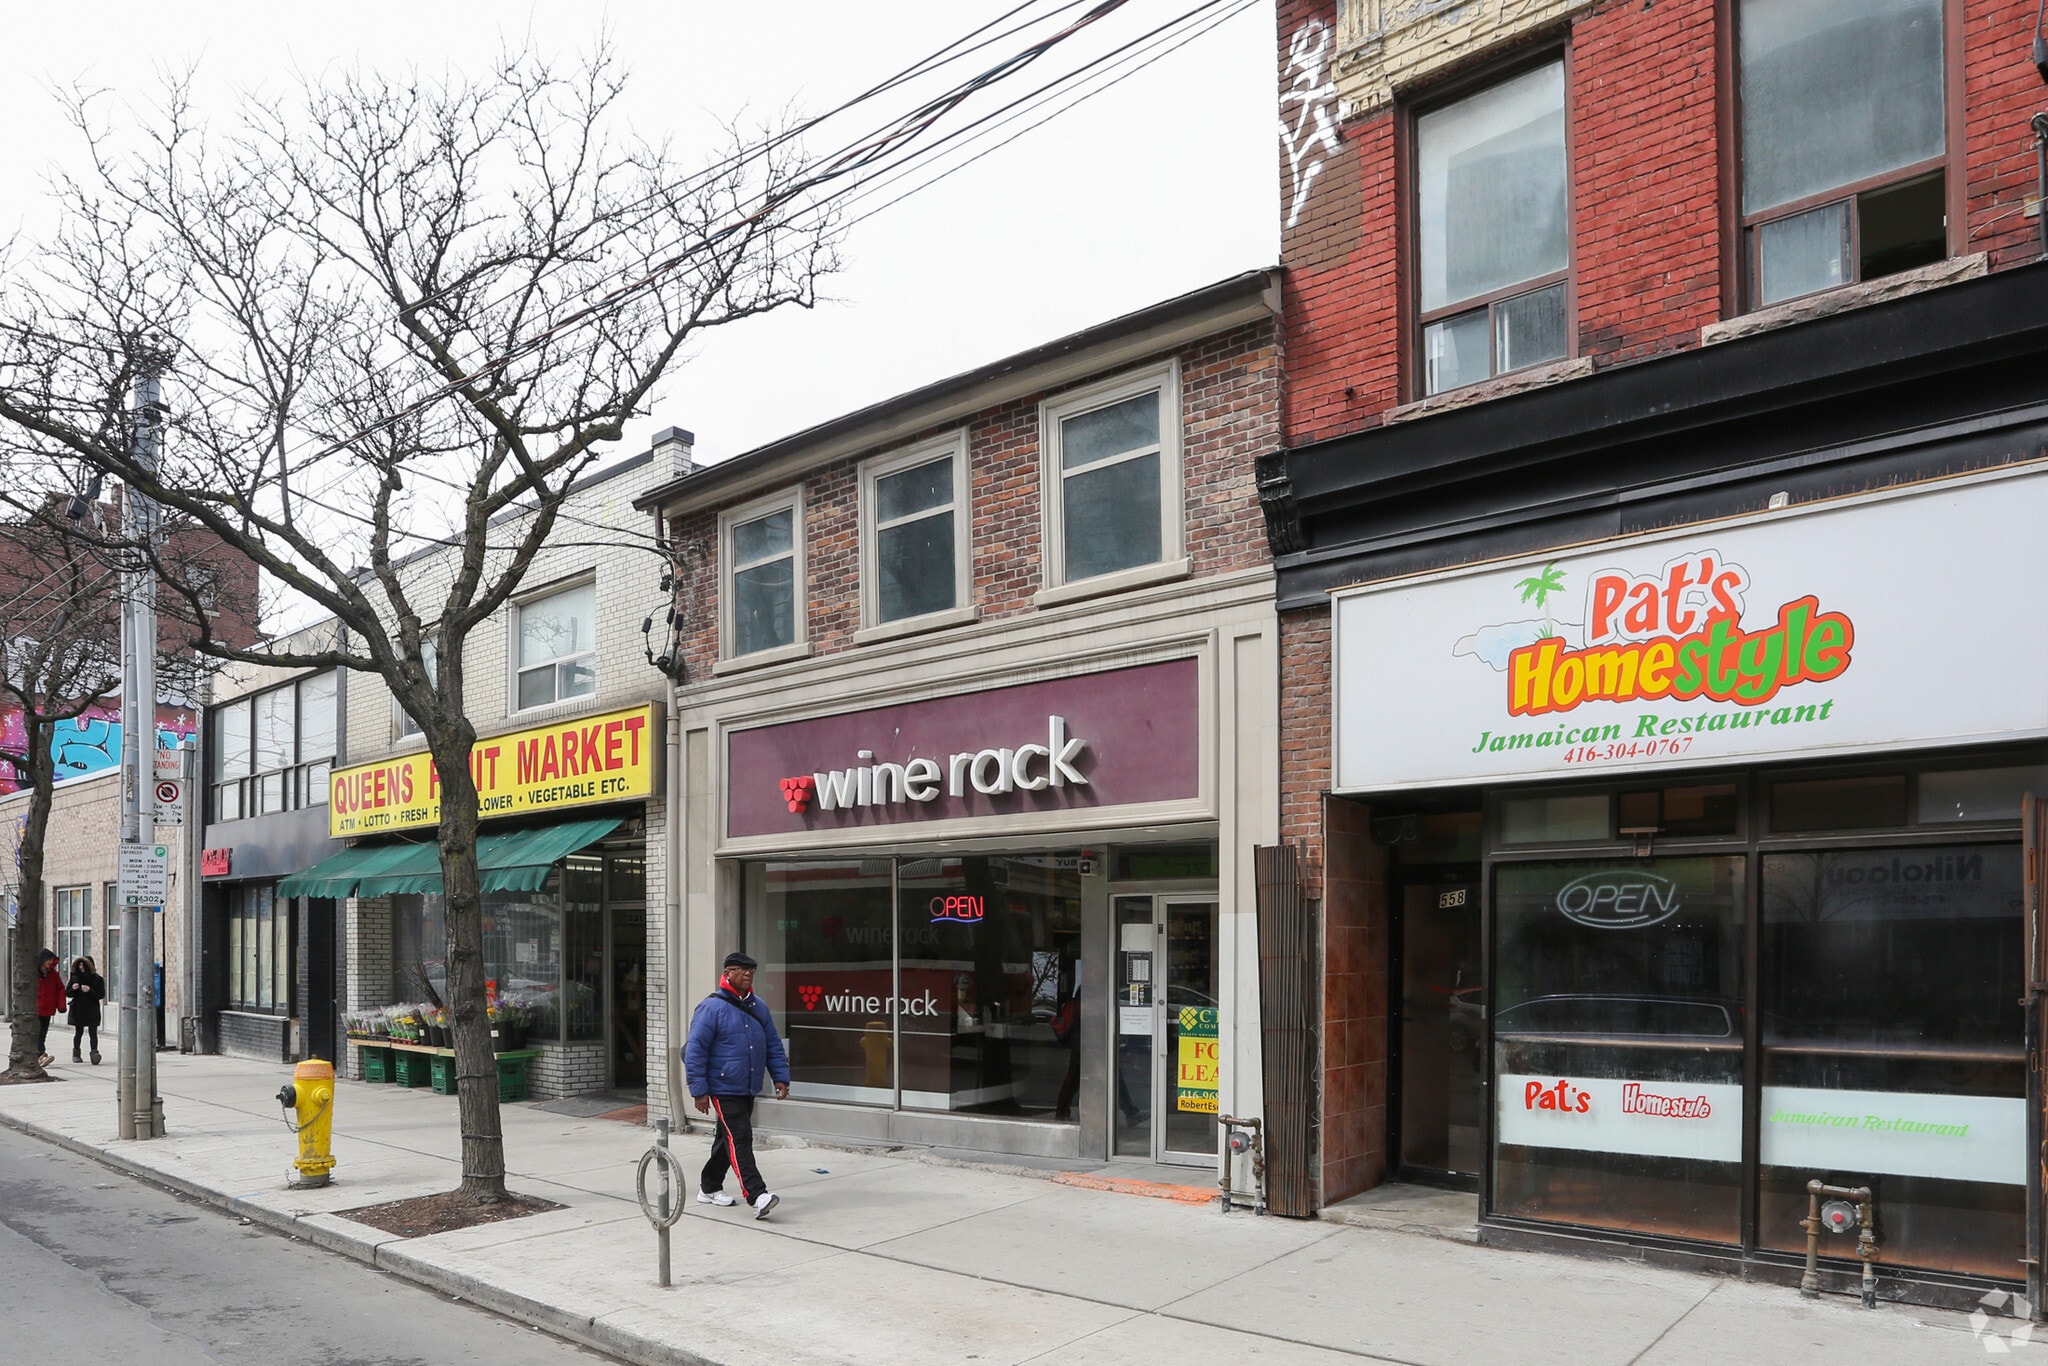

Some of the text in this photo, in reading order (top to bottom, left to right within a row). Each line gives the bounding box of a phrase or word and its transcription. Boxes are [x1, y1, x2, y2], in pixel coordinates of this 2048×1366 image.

[1591, 557, 1742, 638] Pat's
[1511, 602, 1847, 712] Homestyle
[1472, 699, 1834, 754] Jamaican Restaurant
[160, 751, 171, 759] NO
[813, 715, 1088, 810] wine rack
[1563, 736, 1694, 763] 416-304-0767
[153, 761, 179, 769] TANDING
[334, 715, 645, 815] QUEENS FIT MARKET
[339, 818, 356, 831] ATM
[364, 813, 390, 827] LOTTO
[400, 807, 428, 822] FRESH
[476, 794, 513, 812] LOWER
[528, 782, 595, 804] VEGETABLE
[601, 777, 630, 793] ETC.
[929, 896, 984, 918] OPEN
[1440, 891, 1464, 907] 558
[1563, 884, 1676, 913] OPEN
[824, 988, 880, 1014] wine
[1194, 1042, 1219, 1060] FO
[1181, 1063, 1219, 1082] LEA
[1180, 1099, 1219, 1111] RobertEs
[1525, 1079, 1712, 1119] Pat's Homestyle
[1862, 1115, 1971, 1137] Restaurant
